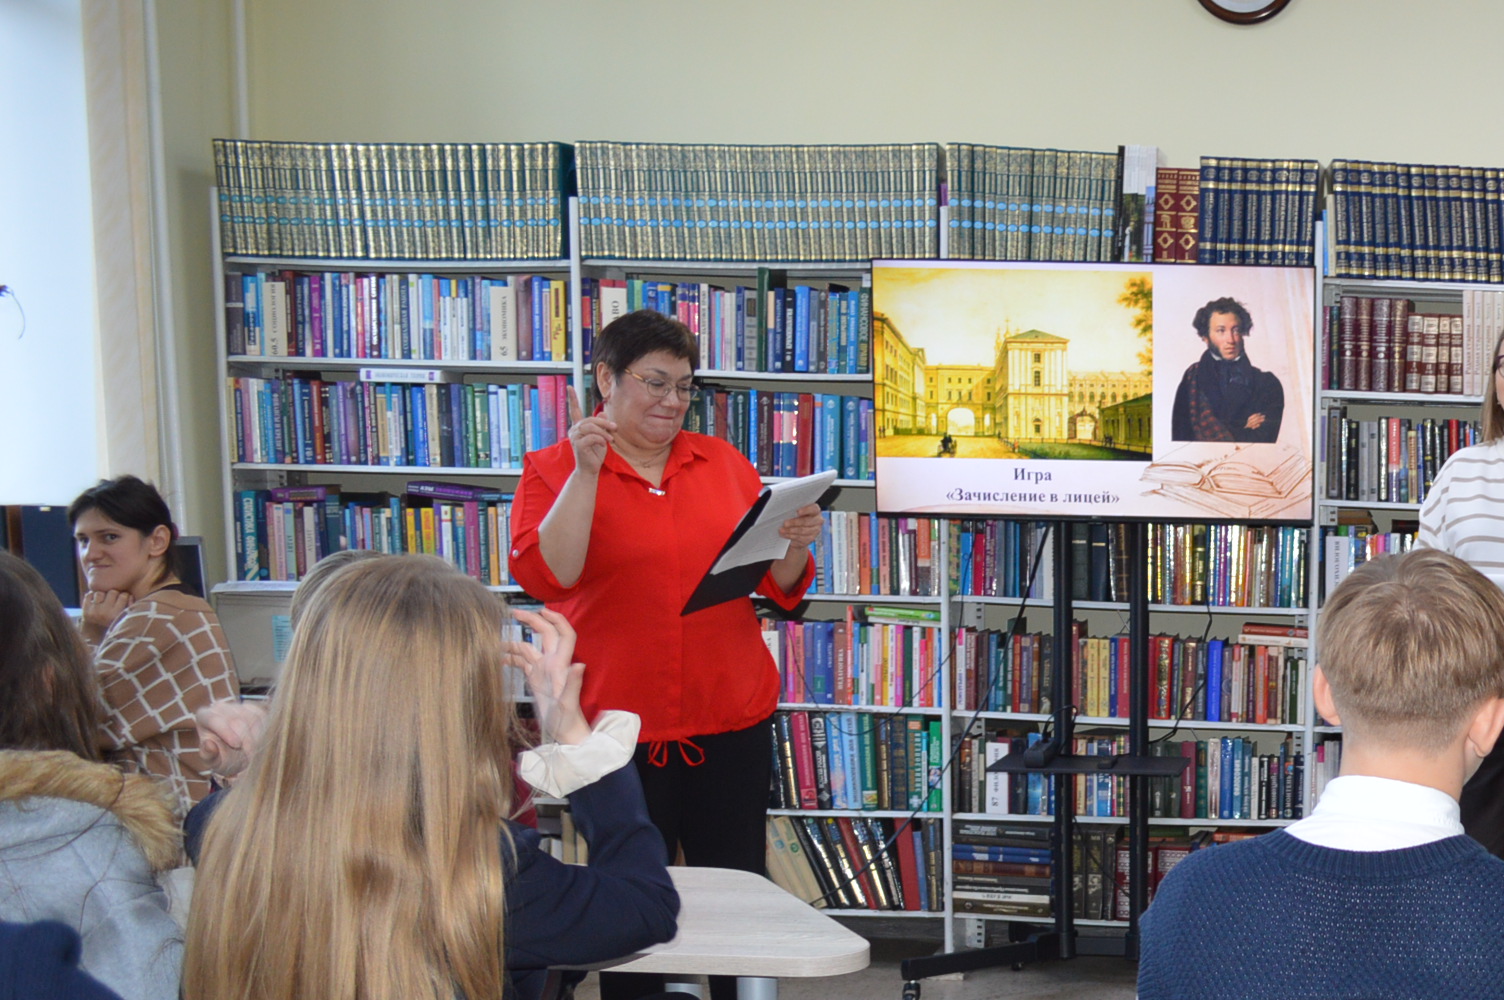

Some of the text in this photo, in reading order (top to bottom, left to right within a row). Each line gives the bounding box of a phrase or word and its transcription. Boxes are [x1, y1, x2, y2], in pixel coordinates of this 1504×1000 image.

[611, 300, 619, 319] АВО
[859, 293, 869, 341] ФИНАНСОВОЕ
[401, 310, 409, 350] СОЦИАЛЬНАЯ
[500, 345, 508, 356] 65
[1014, 467, 1052, 484] Игра
[946, 488, 1120, 505] «Зачисление в лицей»
[243, 497, 255, 533] СТАТИСТИКА
[1233, 759, 1241, 796] ФИЛОСОФИЯ
[992, 797, 999, 807] 87
